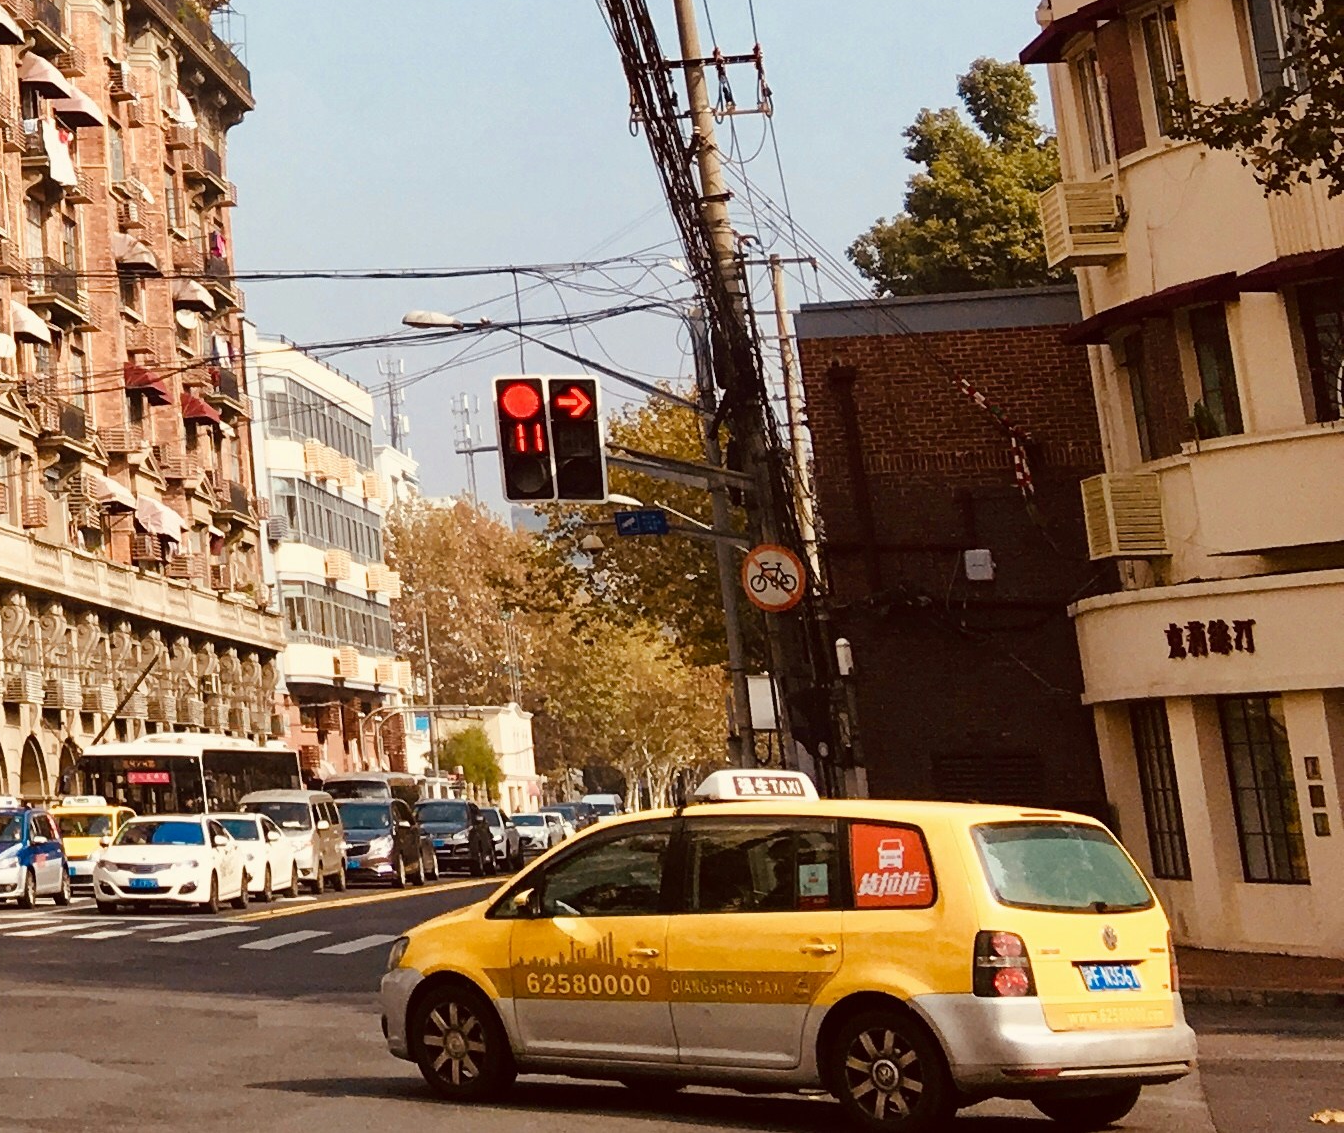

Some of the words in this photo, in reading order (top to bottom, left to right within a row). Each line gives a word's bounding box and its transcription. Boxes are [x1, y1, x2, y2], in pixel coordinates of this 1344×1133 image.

[515, 422, 543, 453] 11
[526, 972, 651, 996] 62580000
[670, 977, 753, 995] QIANGSHENG
[756, 978, 785, 995] TAXI
